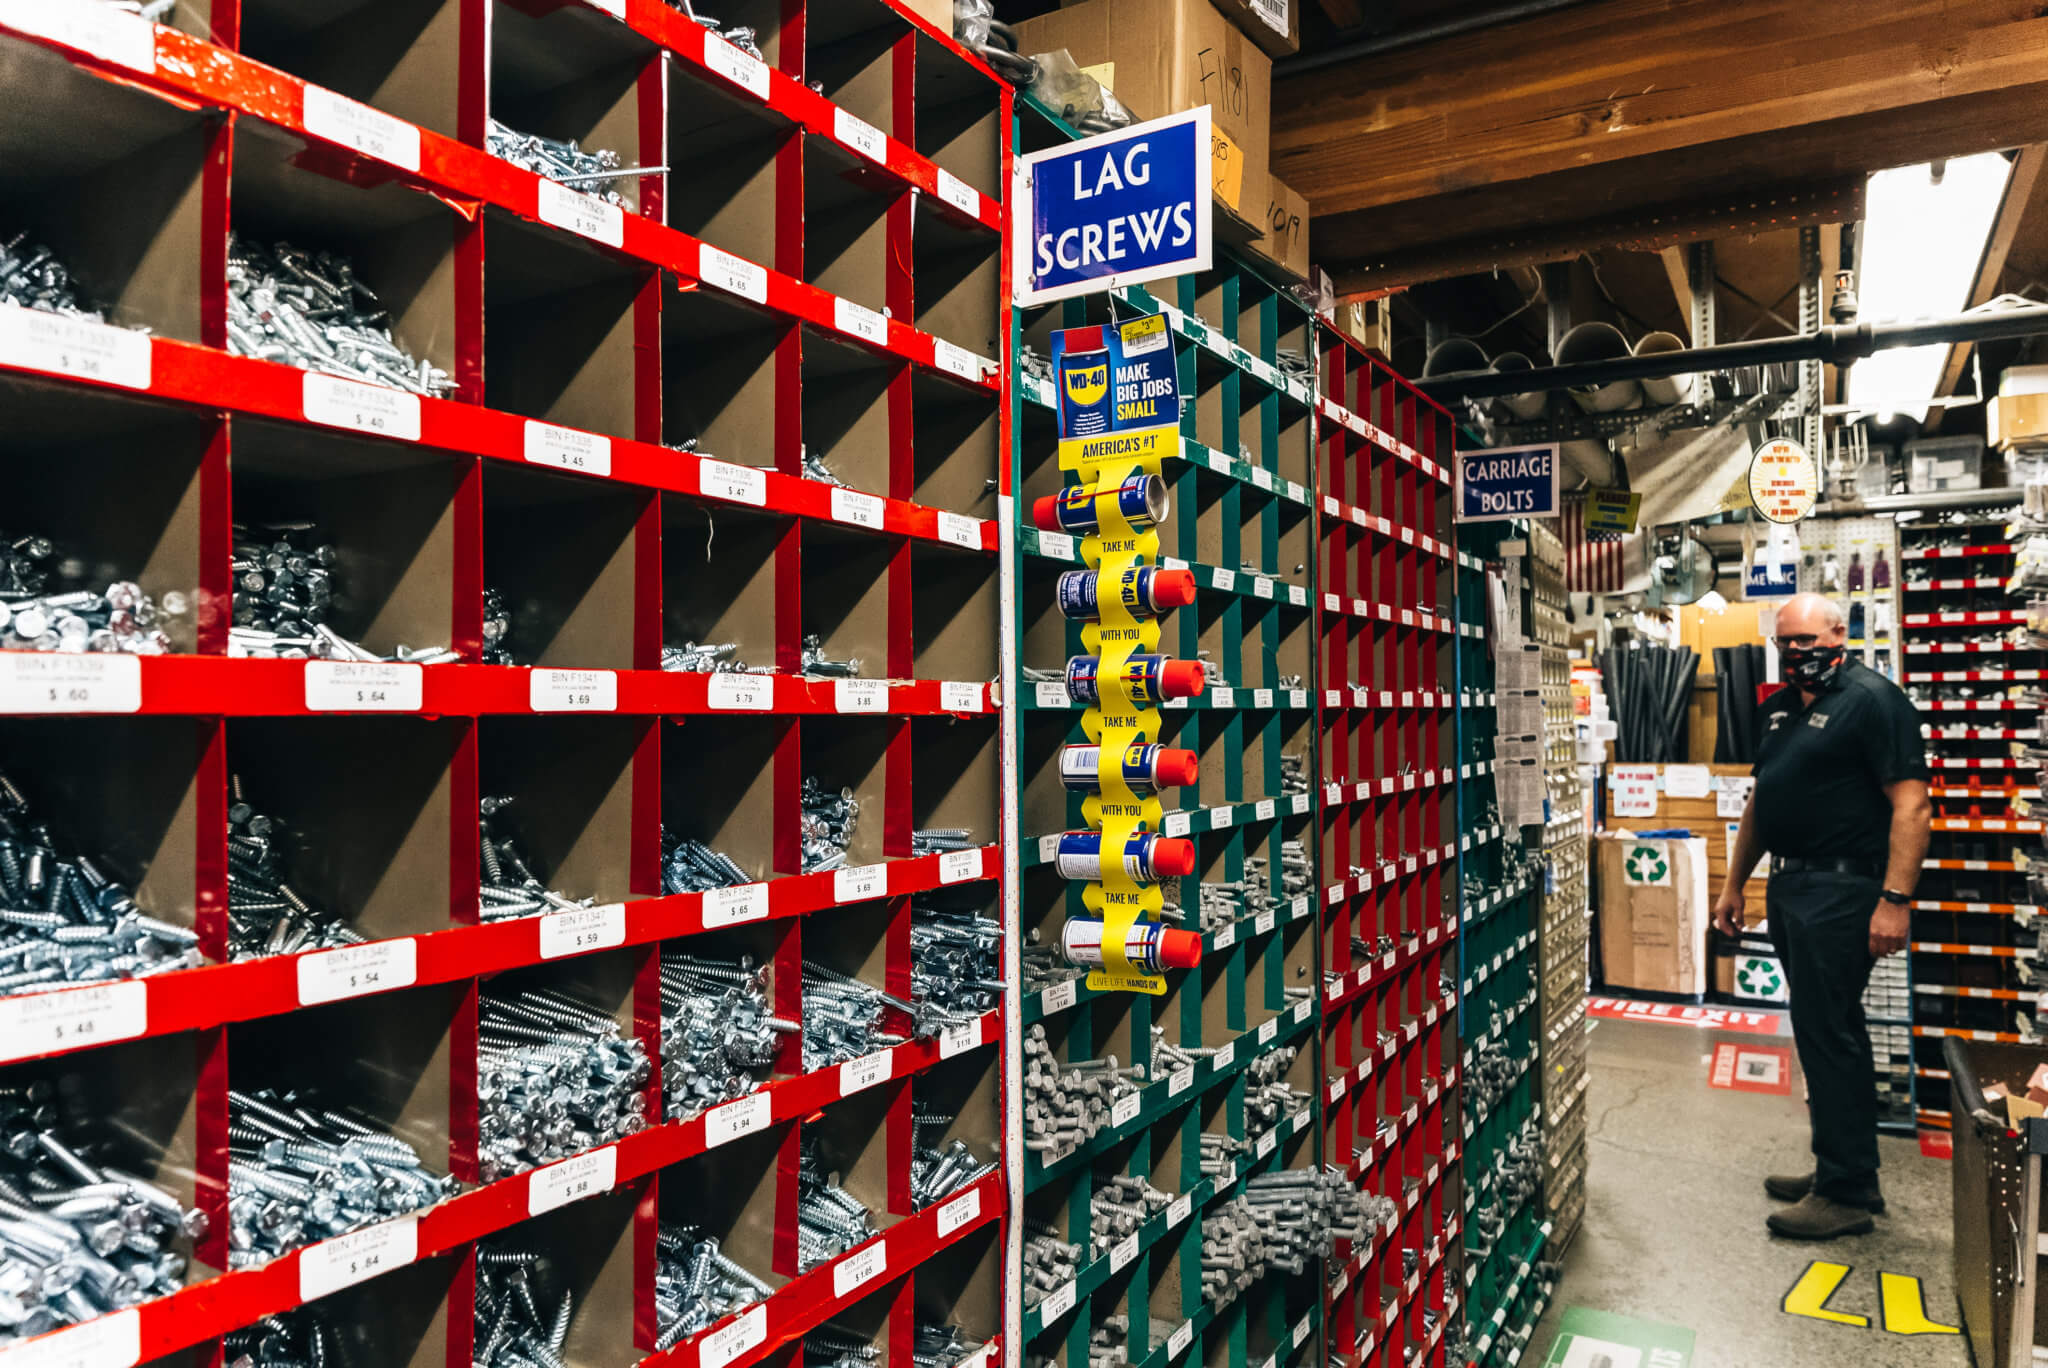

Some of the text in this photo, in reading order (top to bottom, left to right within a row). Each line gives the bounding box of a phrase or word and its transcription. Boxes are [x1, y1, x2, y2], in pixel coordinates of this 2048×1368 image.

[1073, 142, 1150, 201] LAG
[1036, 201, 1192, 277] SCREWS
[1069, 369, 1105, 390] WD-40
[1116, 363, 1150, 384] MAKE
[1117, 377, 1173, 403] BIG JOBS
[1117, 399, 1158, 421] SMALL
[544, 428, 561, 441] BIN
[1082, 437, 1140, 459] AMERICA'S
[715, 464, 729, 476] BIN
[1465, 455, 1550, 482] CARRIAGE
[1481, 489, 1534, 512] BOLTS
[1102, 539, 1136, 553] TAKE ME
[1749, 570, 1795, 587] MEIC
[1100, 628, 1140, 641] WITH YOU
[334, 664, 356, 677] BIN
[551, 671, 568, 682] BIN
[722, 673, 737, 683] BIN
[847, 680, 859, 688] BIN
[576, 694, 590, 705] .69
[742, 694, 753, 703] .79
[1103, 716, 1137, 728] TAKE ME
[1101, 804, 1142, 817] WITH YOU
[718, 887, 731, 899] BIN
[1105, 892, 1139, 905] TAKE ME
[559, 913, 577, 927] BIN
[585, 933, 598, 944] .59
[1092, 976, 1108, 987] LIVE
[1126, 978, 1147, 989] HANDS
[1148, 981, 1158, 990] ON
[1592, 998, 1767, 1026] FIRE EXIT
[719, 1104, 733, 1117] BIN
[550, 1166, 566, 1180] BIN
[327, 1240, 350, 1256] BIN
[713, 1331, 727, 1346] BIN
